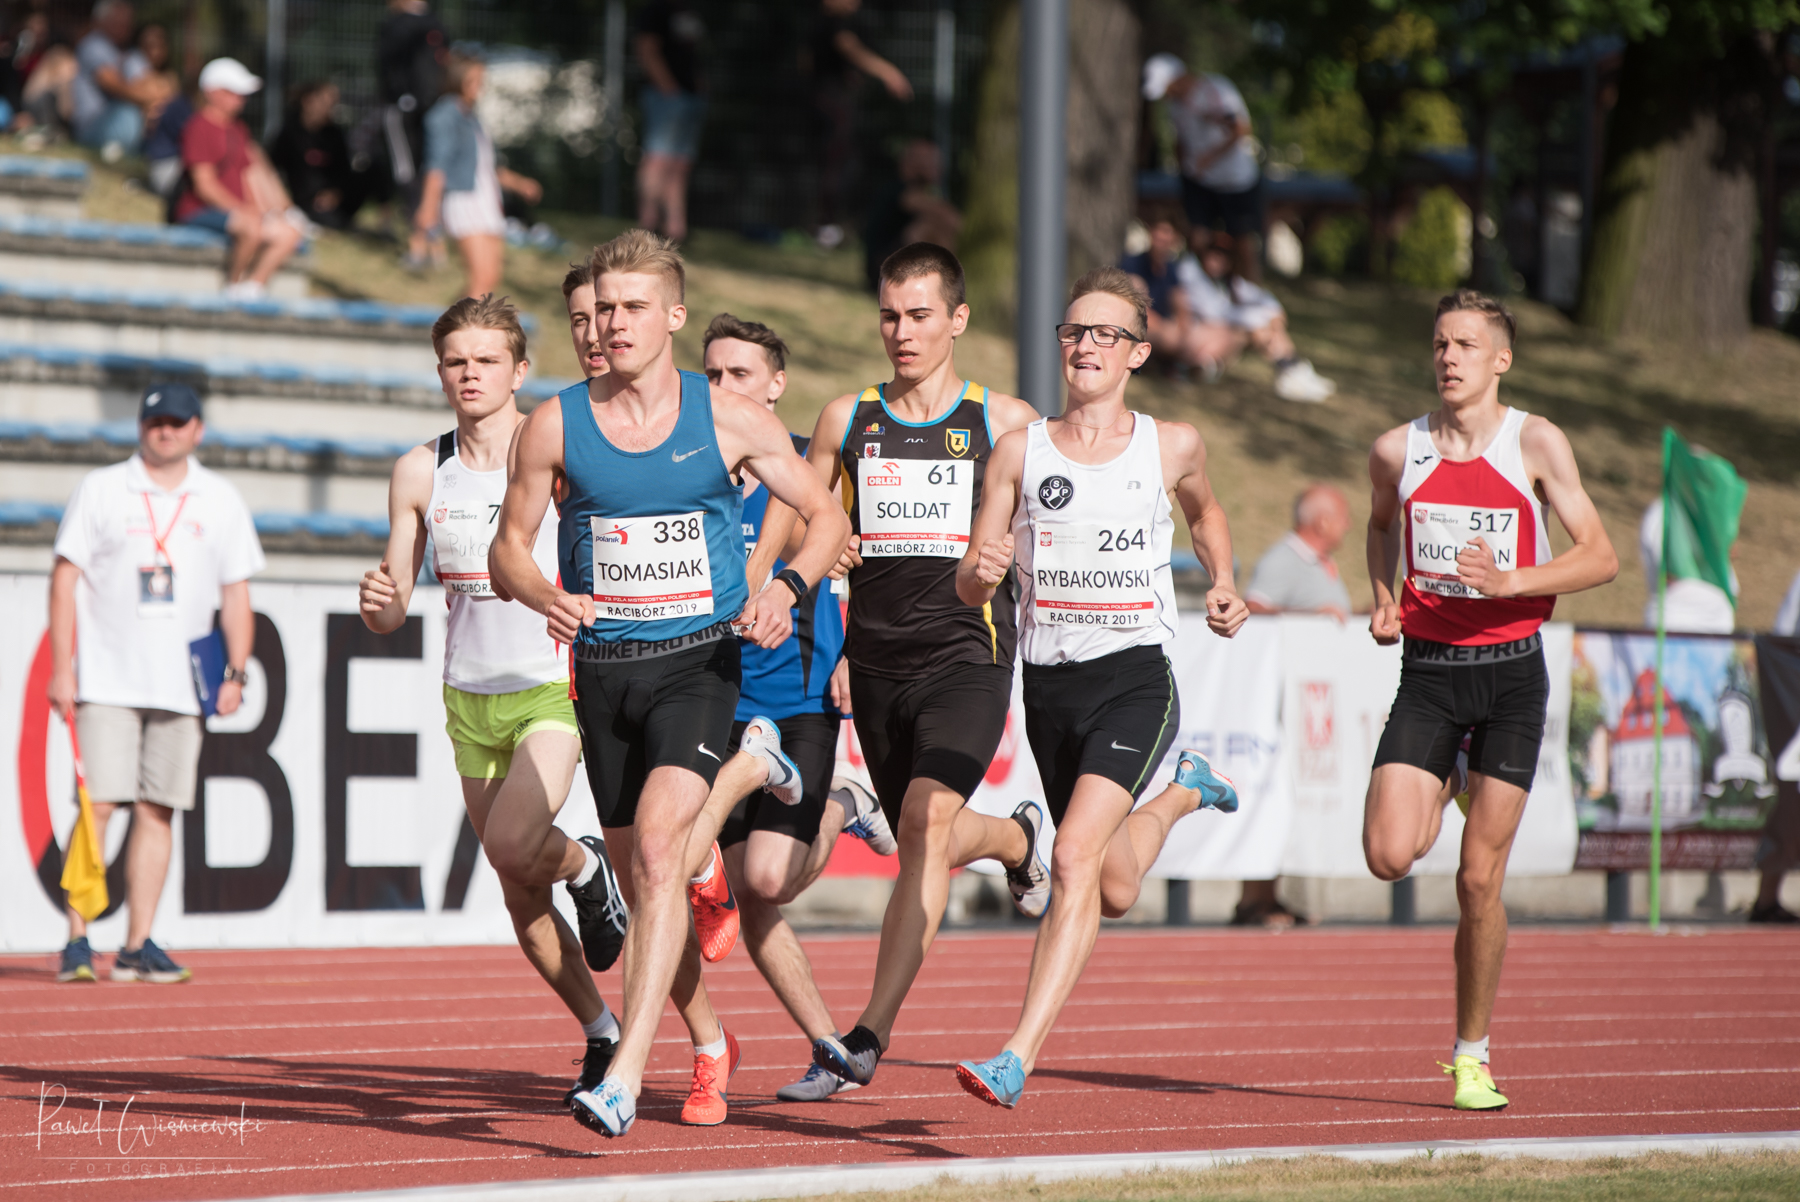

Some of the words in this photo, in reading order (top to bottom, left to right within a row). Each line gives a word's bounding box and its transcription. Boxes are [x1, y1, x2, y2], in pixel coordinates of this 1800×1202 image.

[868, 477, 900, 485] ORLEN
[928, 464, 958, 485] 61
[877, 501, 951, 519] SOLDAT
[653, 518, 700, 543] 338
[1469, 511, 1513, 532] 517
[595, 535, 620, 543] polanik
[872, 541, 925, 554] RACIBÓRZ
[929, 543, 955, 554] 2019
[1098, 528, 1146, 551] 264
[1418, 541, 1510, 564] KUCHN
[598, 558, 703, 581] TOMASIAK
[1037, 569, 1150, 589] RYBAKOWSKI
[627, 595, 667, 603] MISTRZOSTWA
[607, 605, 665, 618] RACIBÓRZ
[669, 603, 697, 616] 2019
[1050, 611, 1108, 624] RACIBÓRZ
[1112, 614, 1140, 625] 2019
[588, 642, 633, 660] NIKE
[637, 637, 683, 657] PRO
[1408, 639, 1469, 662] NIKE
[1474, 637, 1532, 661] PRO
